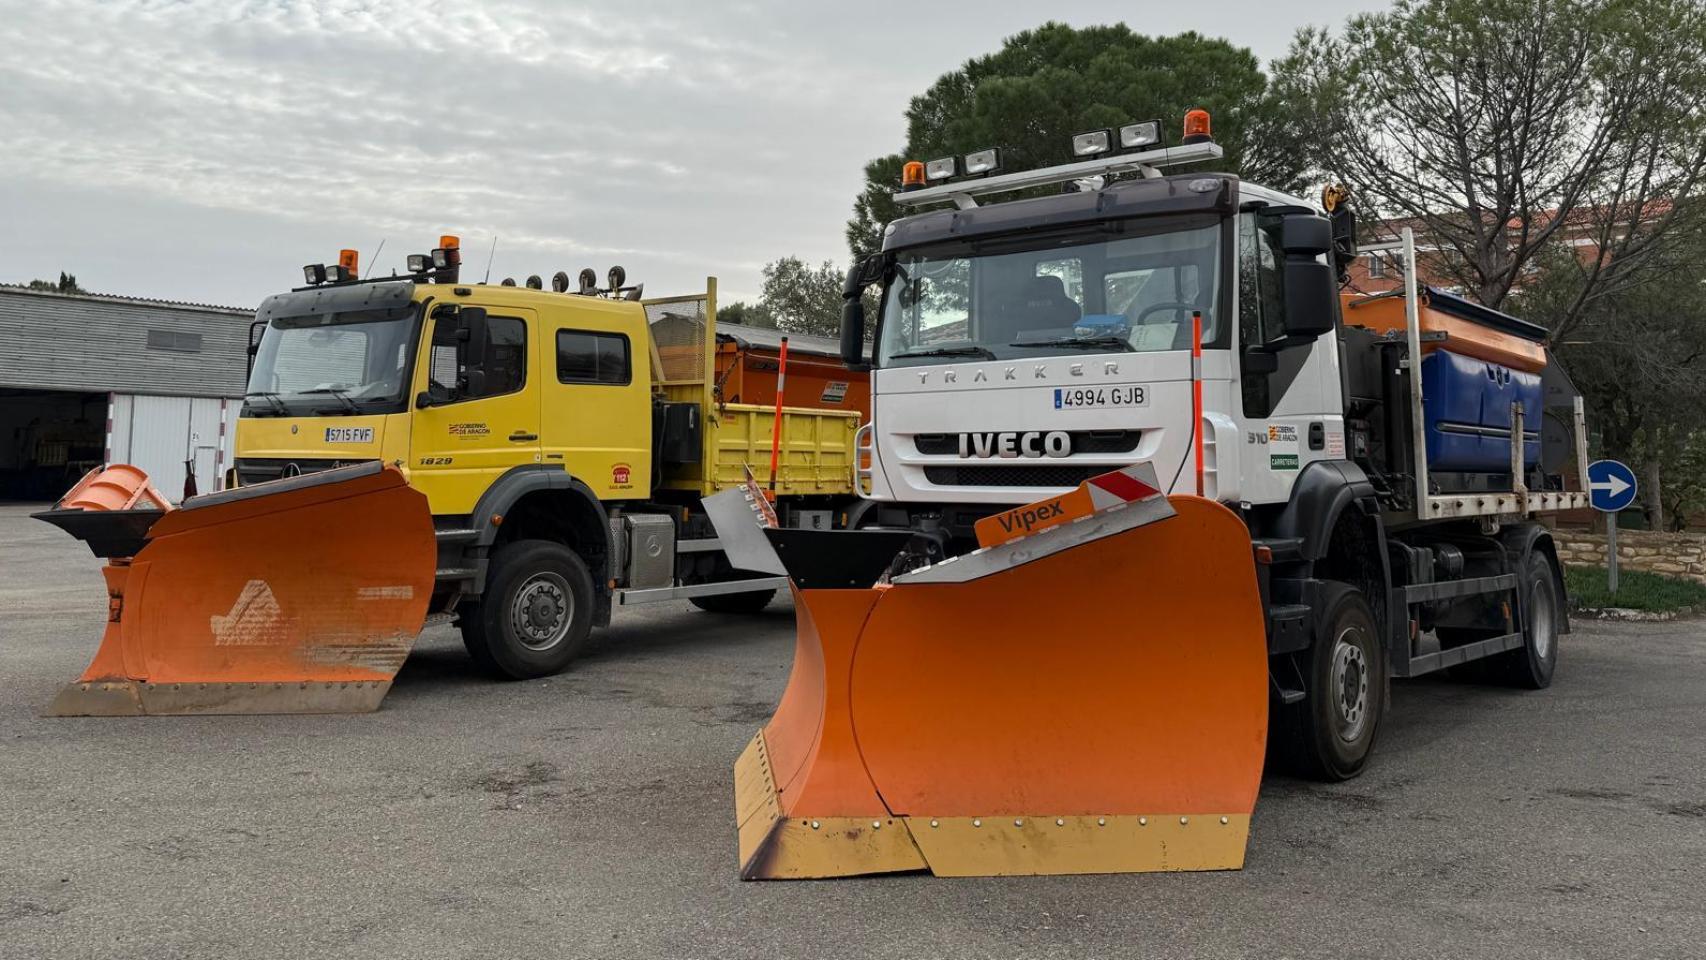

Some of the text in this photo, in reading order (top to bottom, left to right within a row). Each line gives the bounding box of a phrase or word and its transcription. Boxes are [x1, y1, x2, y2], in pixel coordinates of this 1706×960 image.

[917, 361, 1119, 384] TRAKKER
[1064, 387, 1145, 406] 4994 GJB
[331, 428, 371, 441] 5715 FVF
[1248, 432, 1268, 444] 310
[958, 431, 1072, 458] IVECO
[420, 457, 453, 465] 1829
[1271, 458, 1298, 466] CARRETERAS
[998, 500, 1064, 533] Vipex
